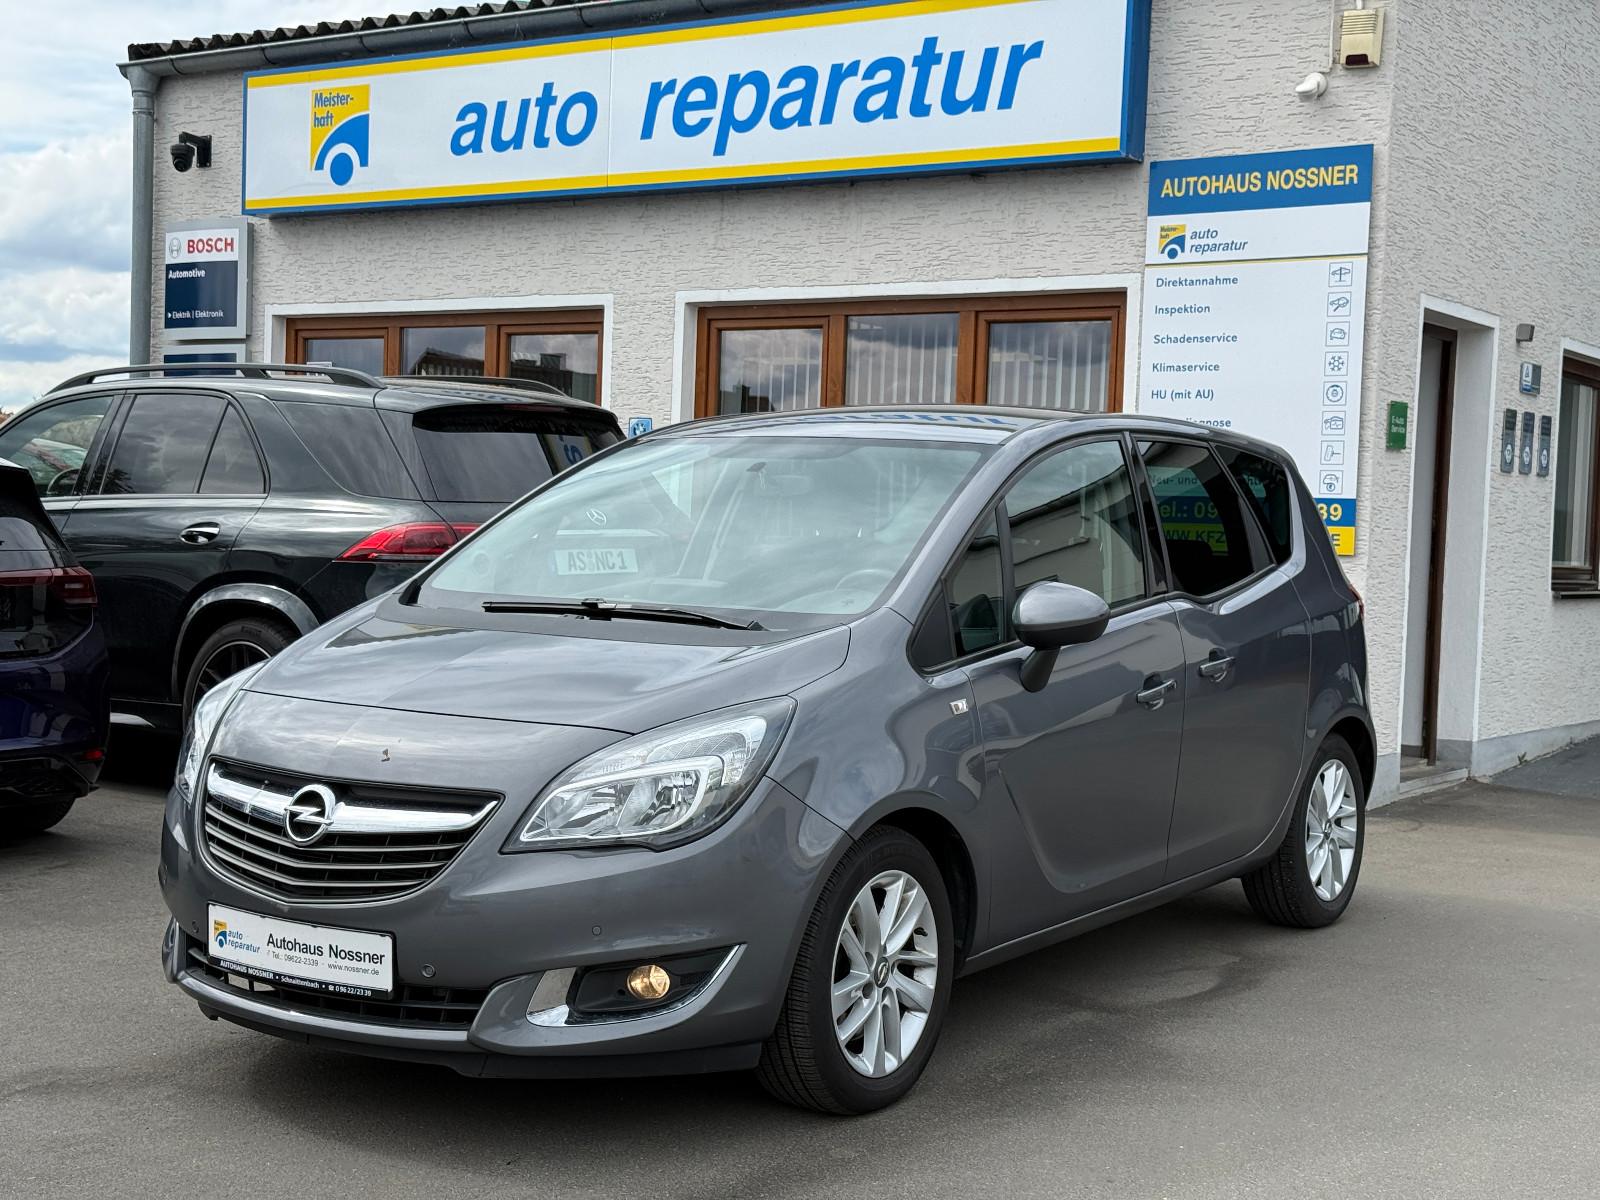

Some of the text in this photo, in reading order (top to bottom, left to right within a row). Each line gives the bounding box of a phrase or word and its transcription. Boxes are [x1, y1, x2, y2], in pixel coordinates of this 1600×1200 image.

[314, 92, 354, 108] Meister-
[450, 37, 1043, 156] auto reparatur
[313, 110, 334, 128] haft
[1161, 164, 1359, 198] AUTOHAUS NOSSNER
[1190, 228, 1218, 240] auto
[186, 237, 235, 254] BOSCH
[1190, 240, 1248, 255] reparatur
[168, 267, 206, 279] Automotive
[1156, 275, 1239, 288] Direktannahme
[172, 310, 224, 319] Elektrik Elektronik
[1154, 303, 1211, 317] Inspektion
[1153, 332, 1238, 344] Schadenservice
[1152, 361, 1220, 373] Klimaservice
[1151, 389, 1214, 402] HU (mit AU)
[1159, 501, 1343, 521] el.: 09 39
[567, 551, 586, 572] AS
[228, 930, 243, 940] auto
[228, 939, 260, 953] reparatur
[266, 933, 386, 965] Autohaus Nossner
[220, 960, 247, 973] AUTOHAUS
[247, 967, 274, 980] NOSSNER
[327, 963, 380, 976] www.nossner.de
